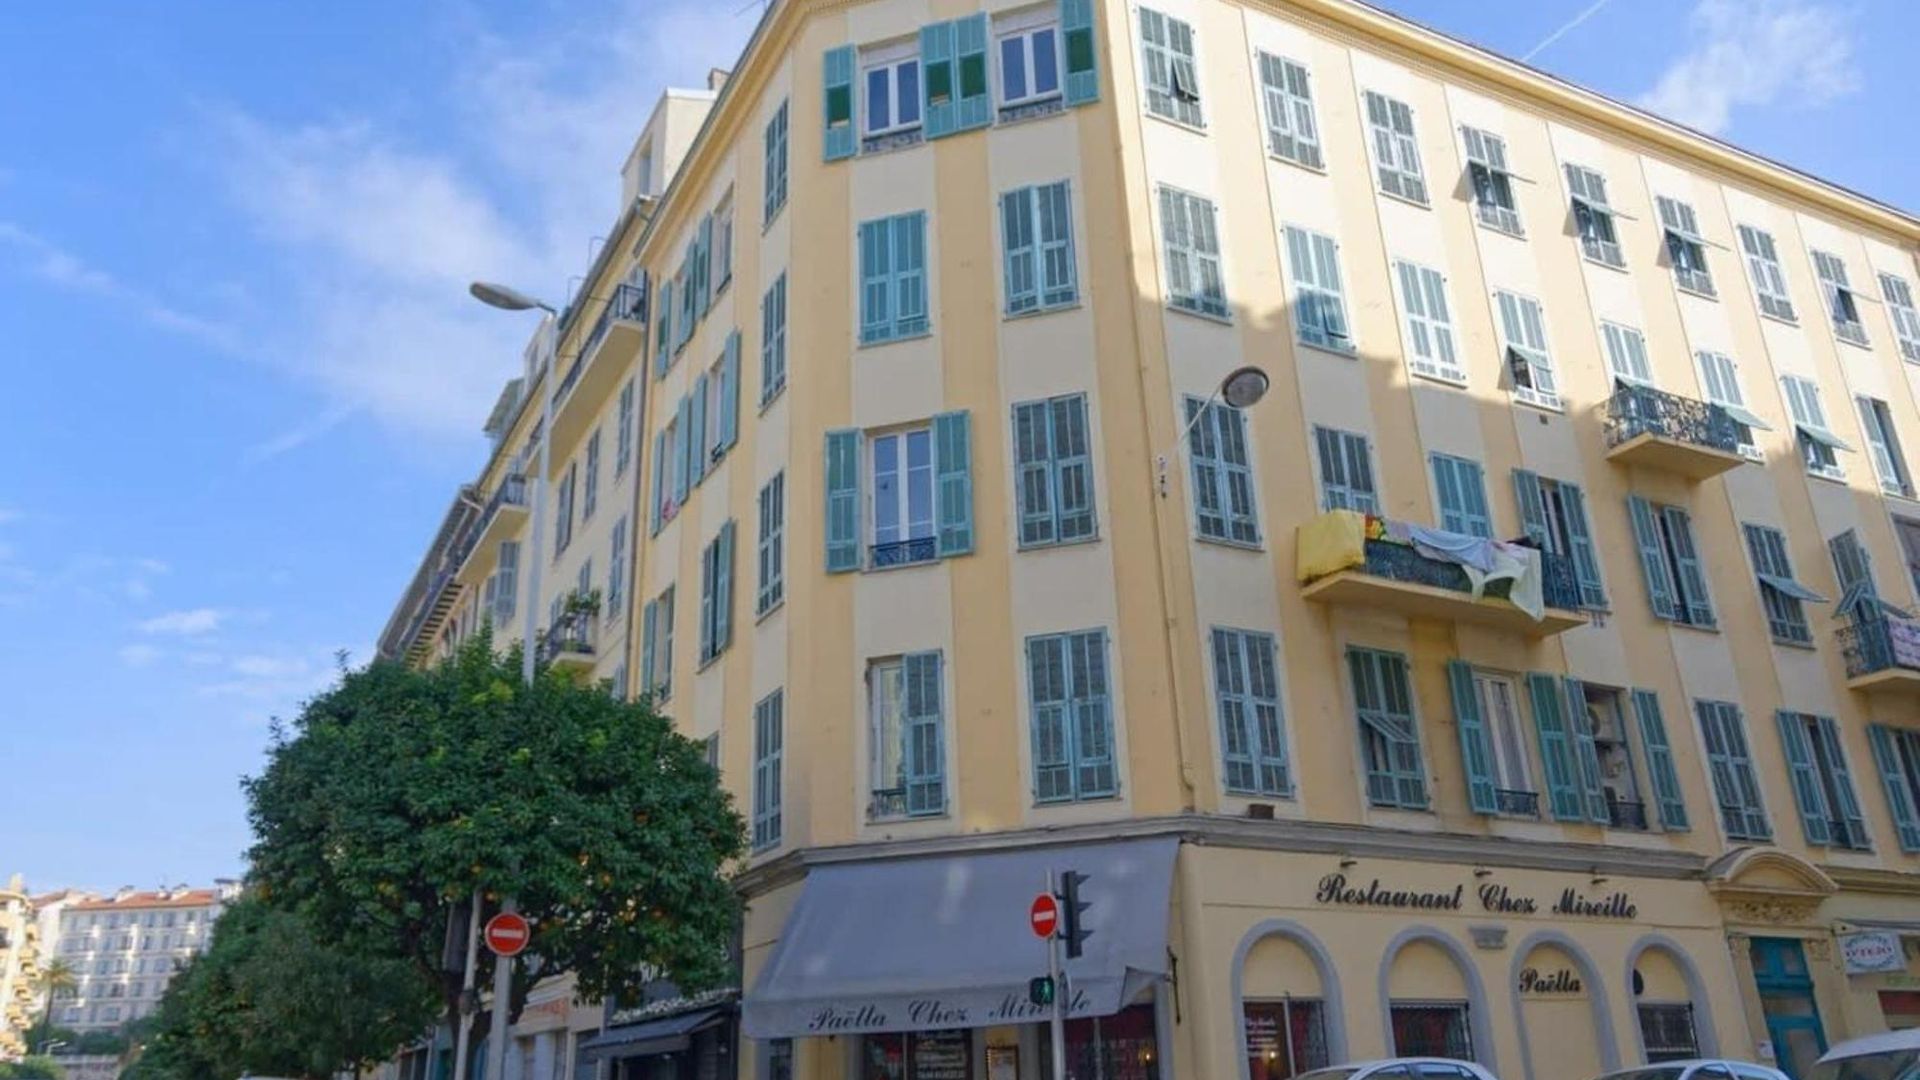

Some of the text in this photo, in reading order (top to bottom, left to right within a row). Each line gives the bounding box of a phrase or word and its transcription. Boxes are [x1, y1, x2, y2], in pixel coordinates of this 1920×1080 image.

[1316, 873, 1638, 919] Restaurant Chez Mireille
[907, 1000, 968, 1024] Chez
